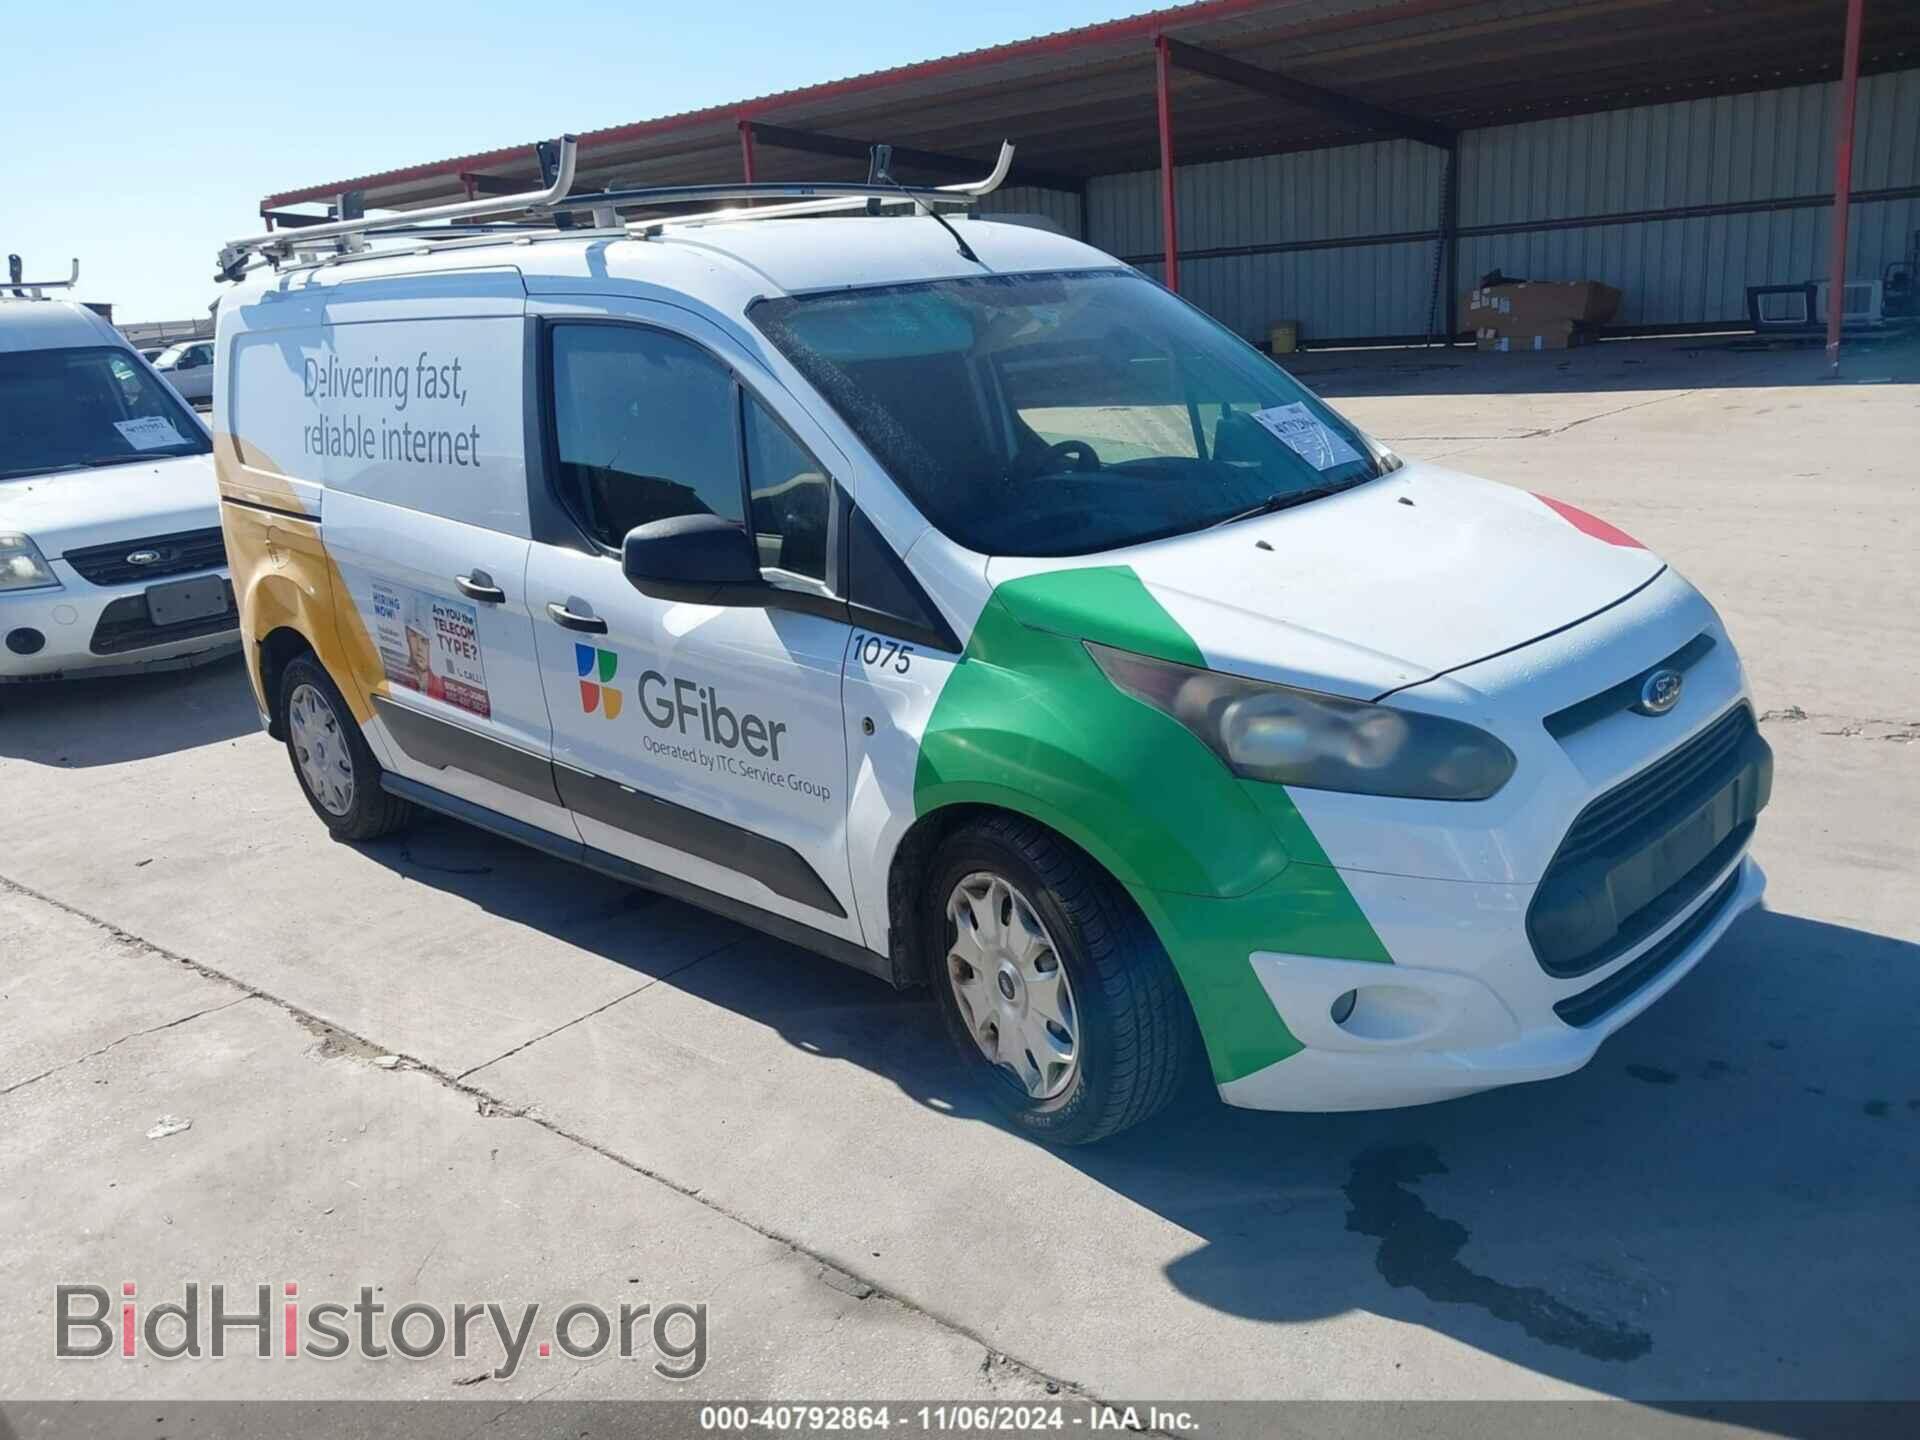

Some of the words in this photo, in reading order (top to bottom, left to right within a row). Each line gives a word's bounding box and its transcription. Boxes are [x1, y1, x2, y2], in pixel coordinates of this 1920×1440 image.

[304, 355, 409, 411] Delivering
[416, 351, 467, 407] fast,
[304, 413, 376, 460] reliable
[382, 417, 480, 468] internet
[433, 617, 476, 641] TELECOM
[445, 608, 461, 621] YOU
[436, 632, 478, 661] TYPE?
[854, 633, 914, 675] 1075
[638, 669, 786, 762] GFiber
[643, 735, 697, 764] Operated
[699, 749, 715, 772] by
[717, 755, 737, 775] ITC
[740, 761, 785, 788] Service
[787, 773, 831, 802] Group
